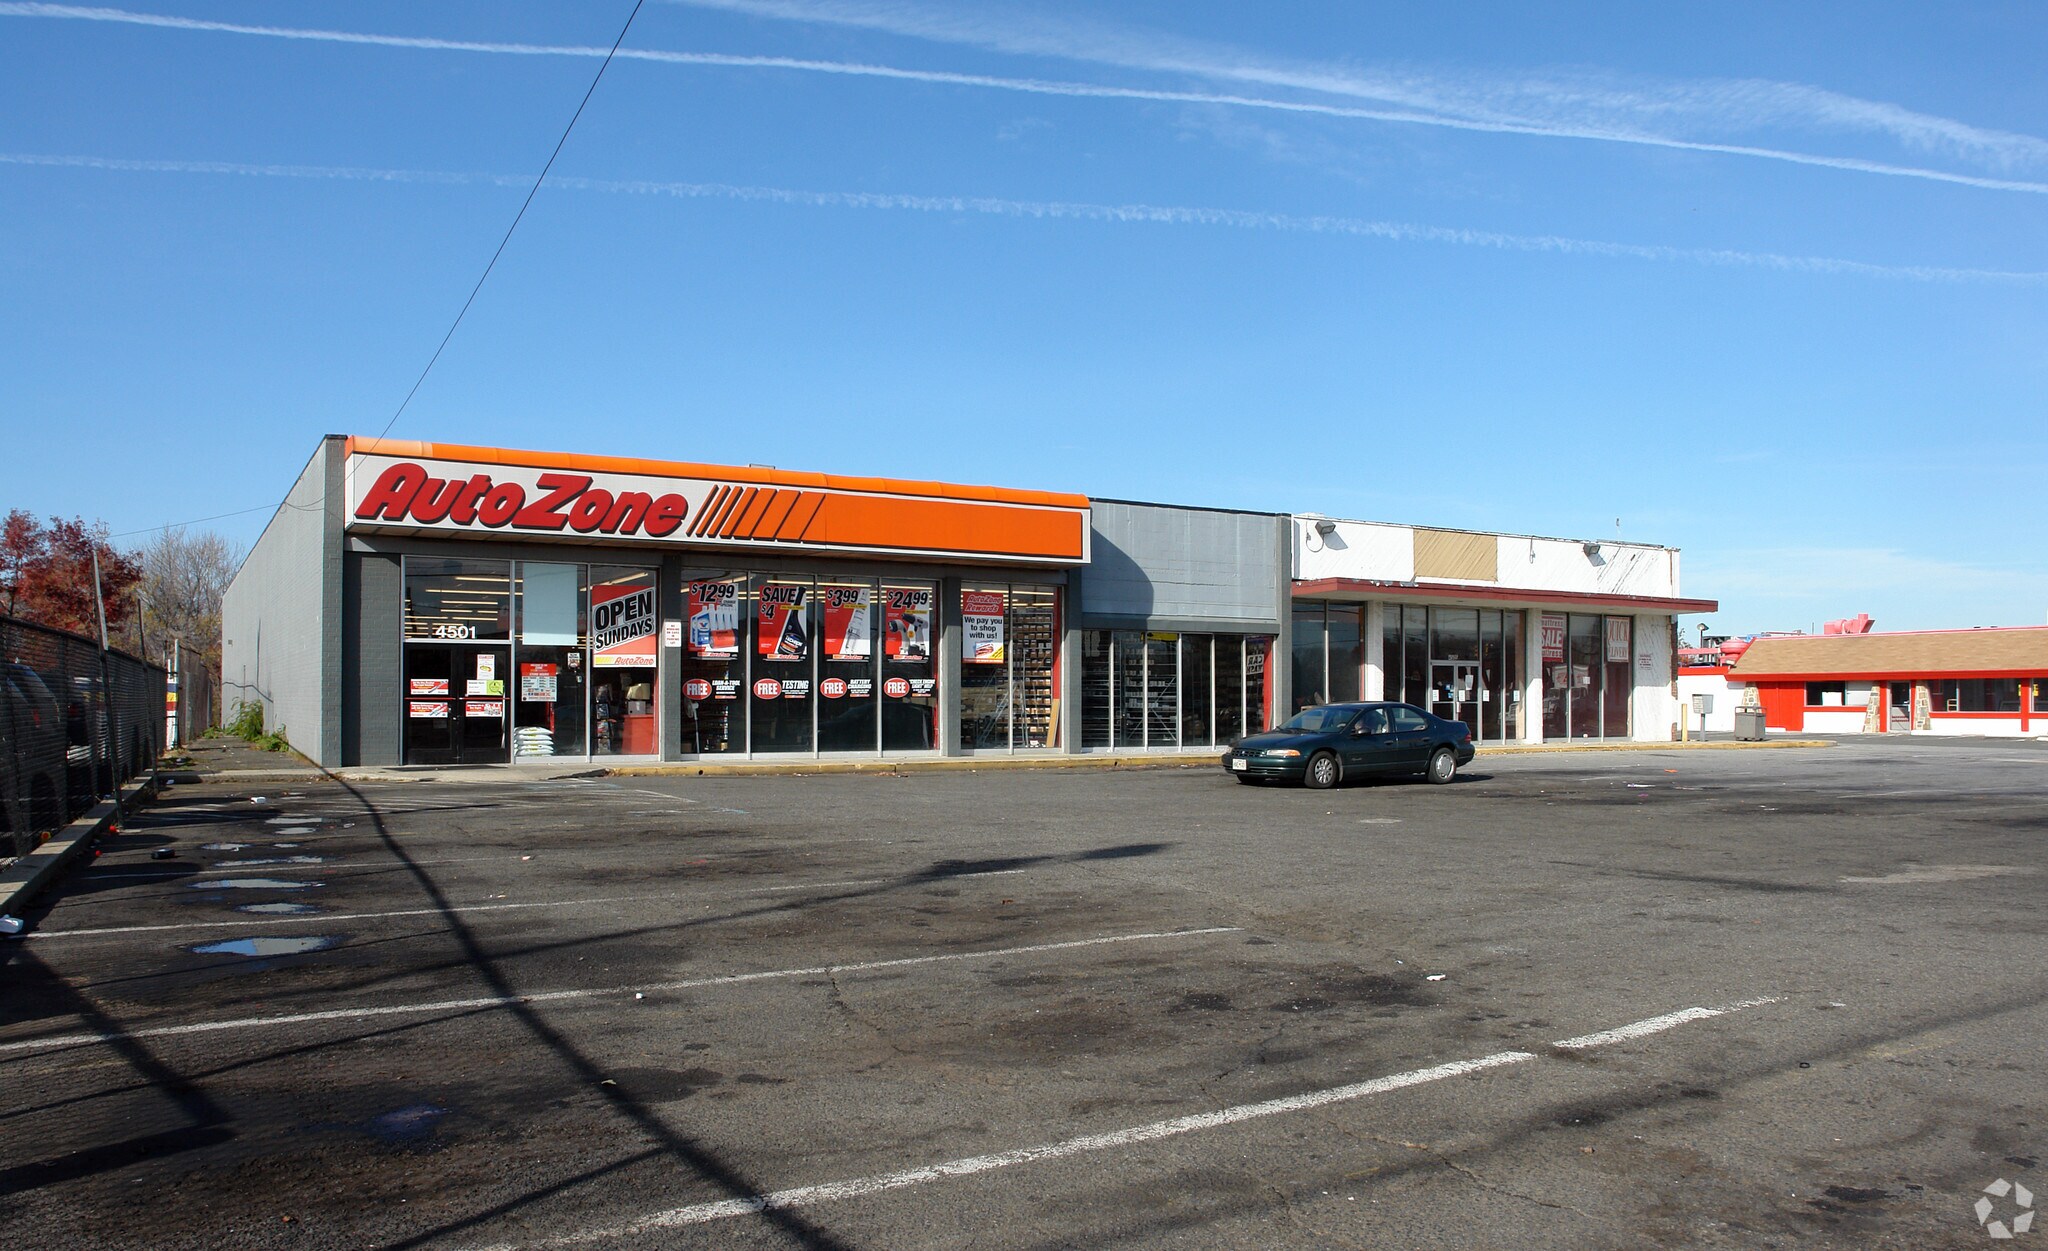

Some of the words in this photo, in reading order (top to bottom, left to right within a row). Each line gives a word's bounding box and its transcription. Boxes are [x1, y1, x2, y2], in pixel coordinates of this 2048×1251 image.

[354, 462, 689, 537] AutoZone
[762, 586, 797, 603] SAVE
[967, 594, 1002, 604] AutoZone
[595, 591, 652, 631] OPEN
[761, 604, 775, 619] $4
[964, 603, 1000, 612] Rewards
[964, 616, 975, 624] We
[435, 625, 477, 639] 4501
[595, 618, 653, 649] SUNDAYS
[980, 625, 997, 633] shop
[1541, 628, 1562, 647] SALE
[614, 657, 654, 665] AutoZone
[686, 683, 708, 696] FREE
[757, 682, 778, 695] FREE
[781, 680, 809, 689] TESTING
[823, 682, 844, 694] FREE
[887, 682, 906, 694] FREE
